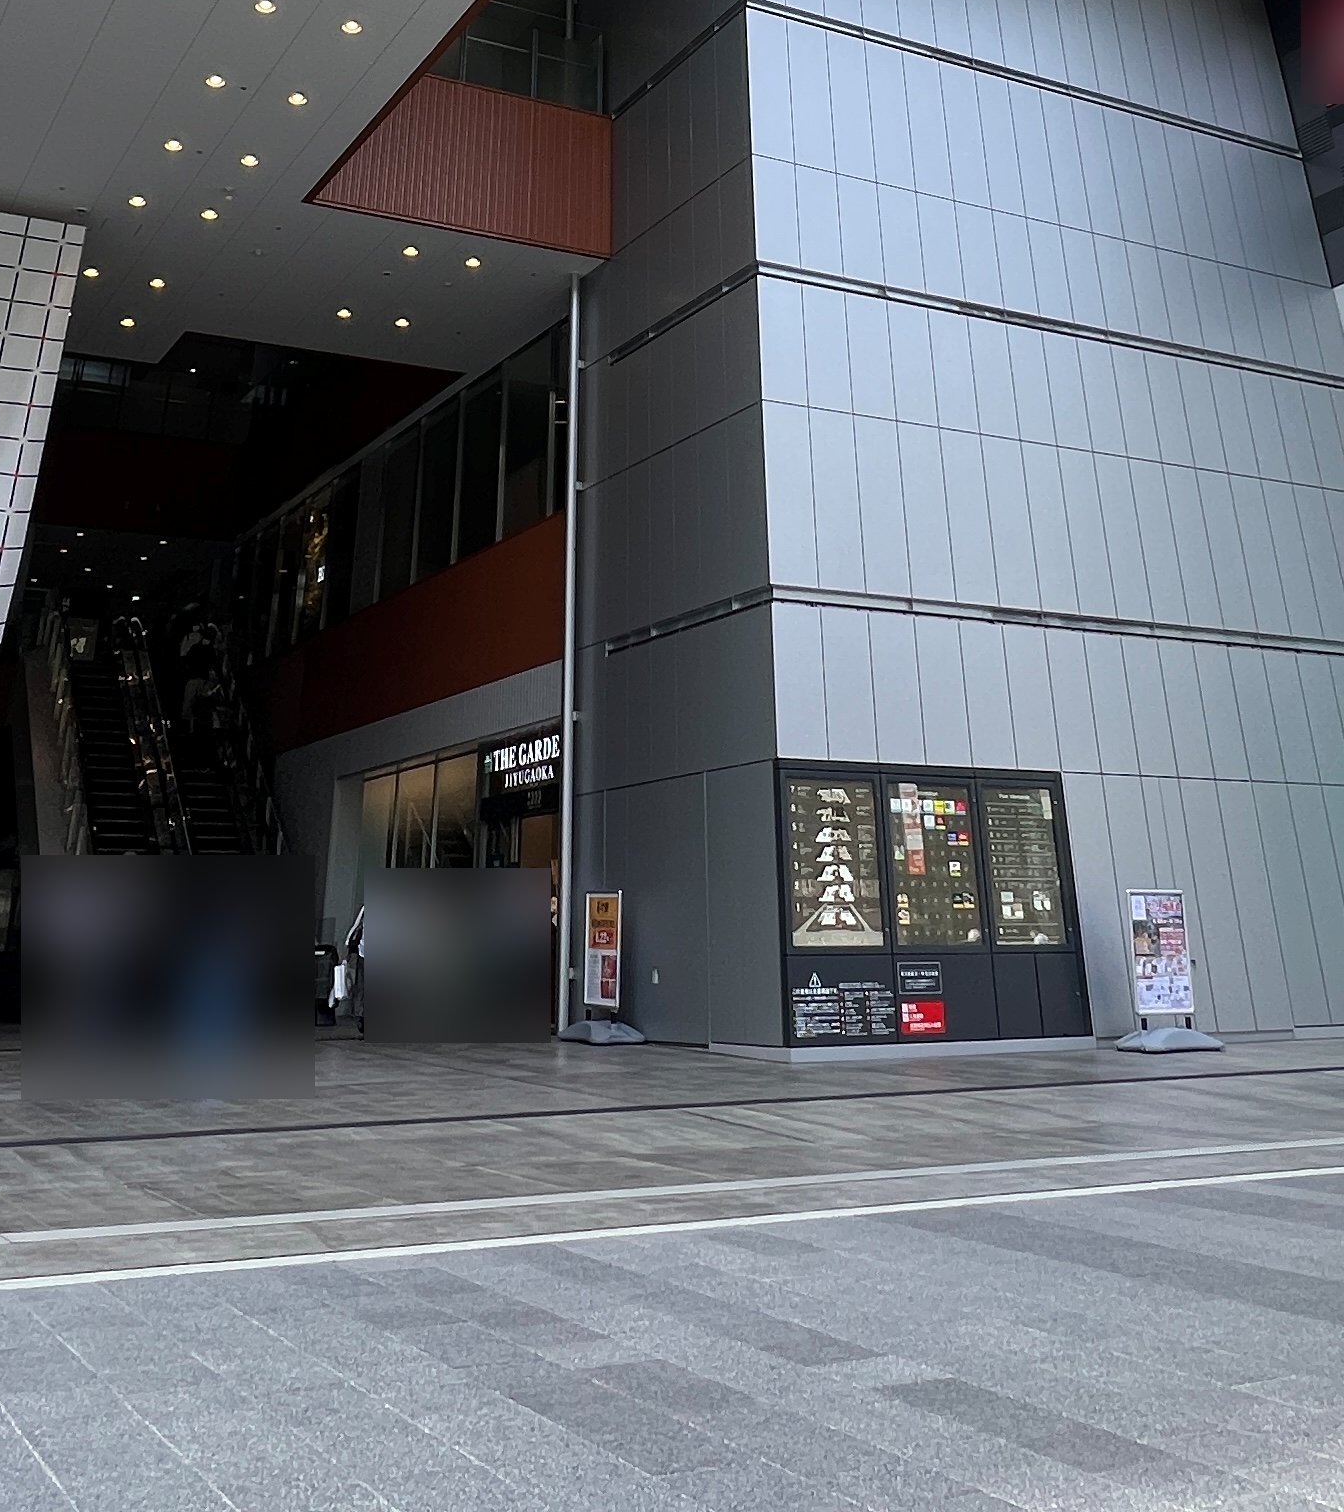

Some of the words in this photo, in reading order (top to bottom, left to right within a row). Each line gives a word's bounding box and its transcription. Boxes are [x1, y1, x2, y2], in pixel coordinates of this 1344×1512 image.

[493, 745, 517, 772] THE
[518, 734, 561, 766] GARDE
[504, 764, 554, 788] JIYUGAOKA
